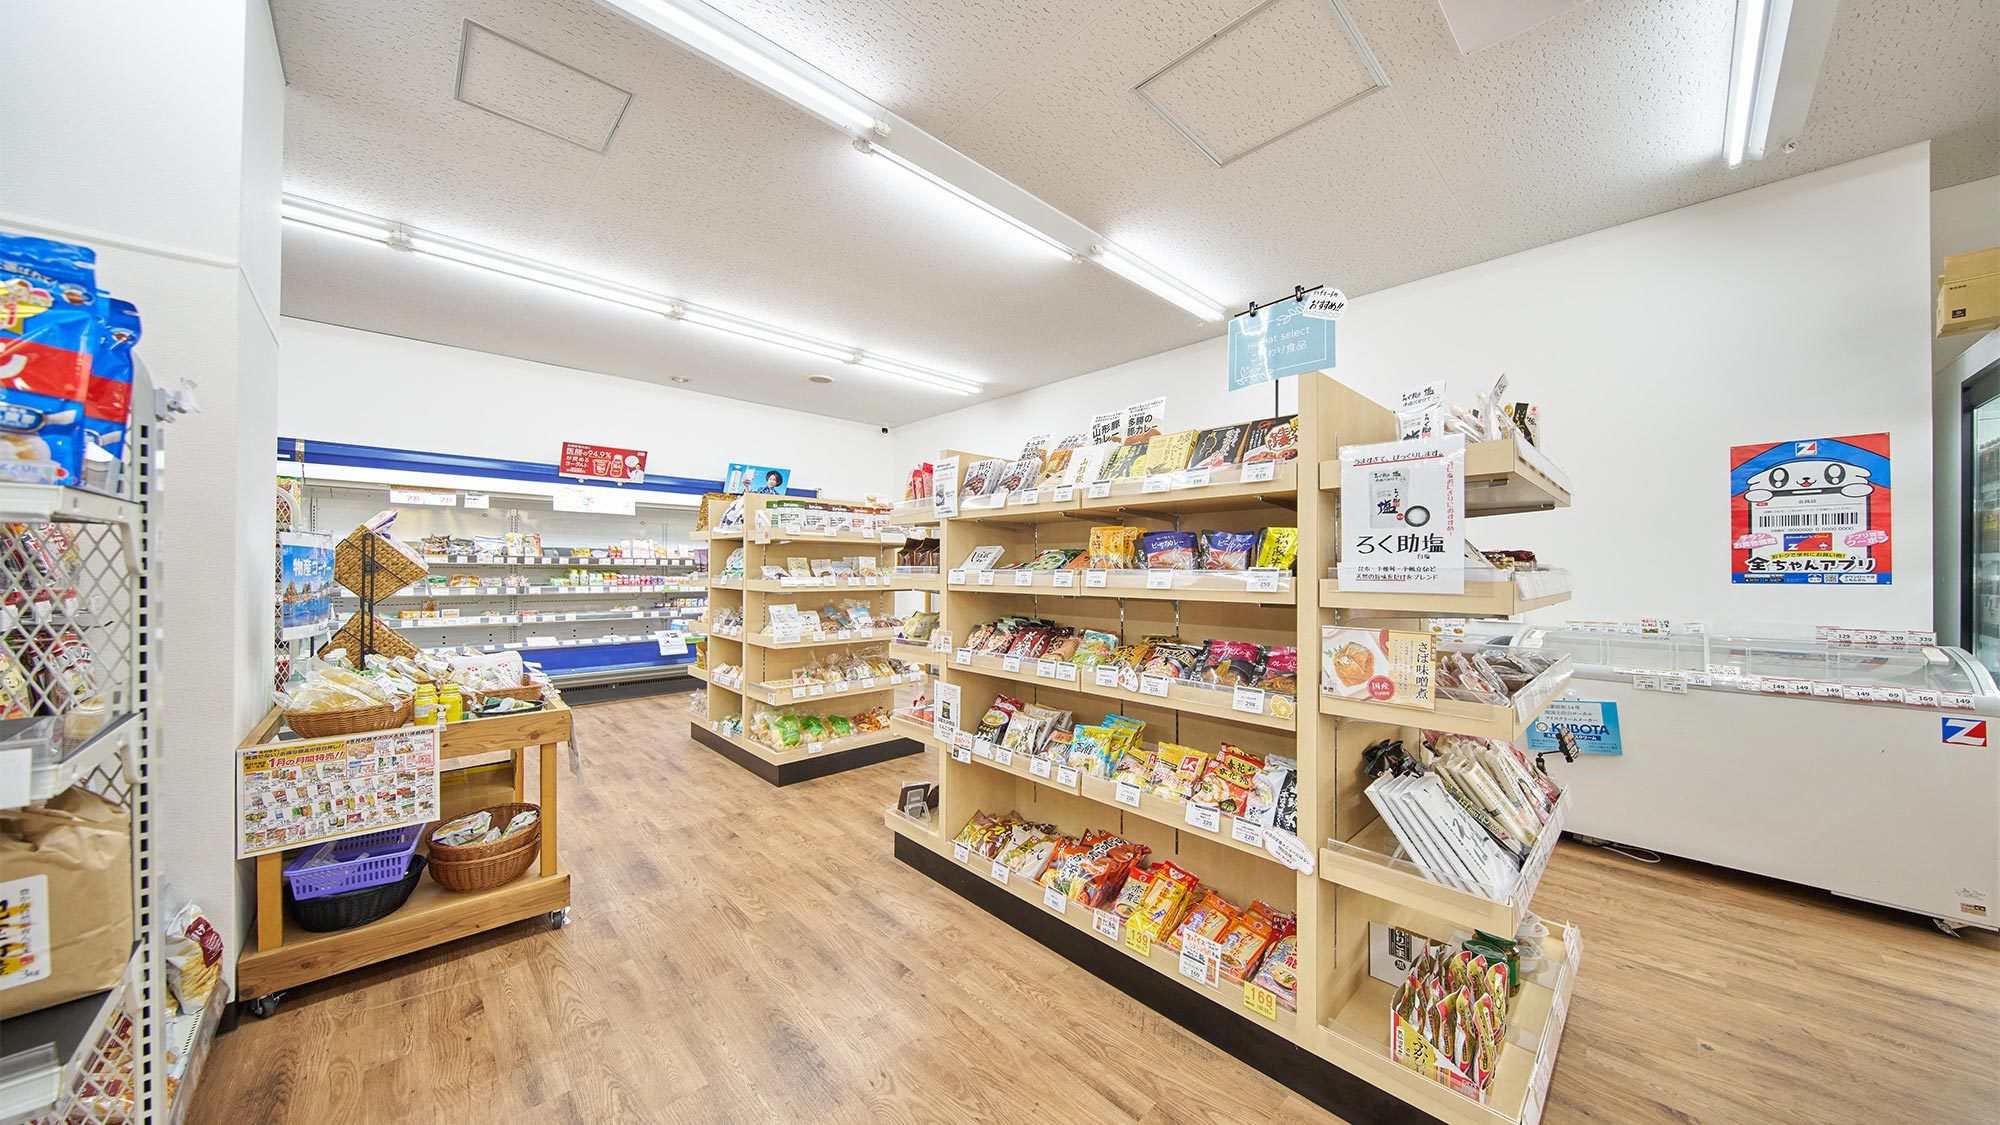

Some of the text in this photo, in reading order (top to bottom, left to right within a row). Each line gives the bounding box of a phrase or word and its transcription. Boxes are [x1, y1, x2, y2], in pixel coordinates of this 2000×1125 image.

[1281, 326, 1310, 341] select
[1092, 419, 1121, 439] 山形豚
[1356, 533, 1446, 555] ろく助塩
[293, 557, 332, 577] 物産コーナー
[1747, 556, 1874, 572] 全ちゃんアプリ
[1415, 641, 1429, 700] さば味噌煮
[268, 751, 344, 768] 1月の月間特売!!
[1131, 928, 1148, 949] 139
[1250, 987, 1273, 1008] 169
